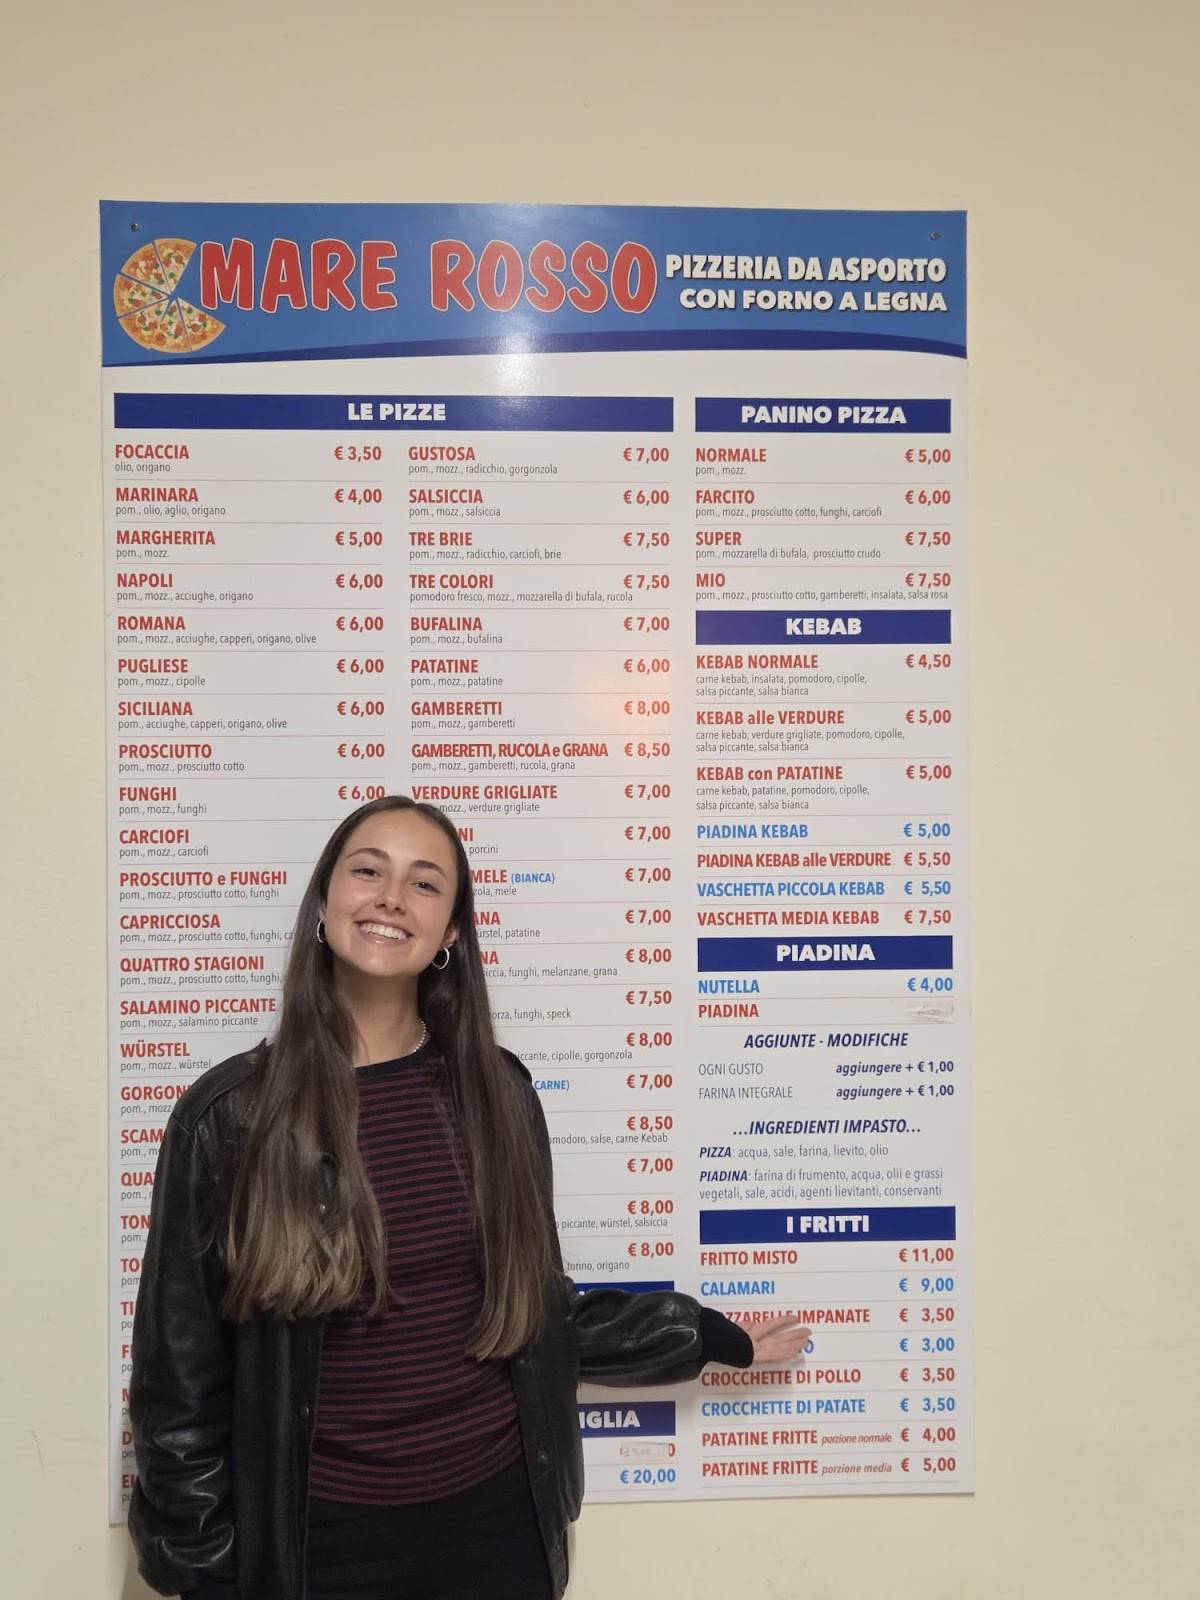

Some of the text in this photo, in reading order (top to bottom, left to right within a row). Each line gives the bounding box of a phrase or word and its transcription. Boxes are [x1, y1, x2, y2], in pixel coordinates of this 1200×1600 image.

[200, 238, 657, 314] MARE ROSSO
[666, 255, 946, 282] PIZZERIA DA ASPORTO
[680, 288, 947, 312] CON FORNO A LEGNA
[348, 404, 446, 421] LE PIZZE
[741, 406, 907, 424] PANINO PIZZA
[115, 444, 190, 460] FOCACCIA
[334, 446, 382, 462] € 3,50
[408, 446, 476, 461] GUSTOSA
[623, 447, 670, 464] € 7,00
[696, 448, 767, 463] NORMALE
[904, 448, 951, 465] € 5,00
[115, 461, 171, 474] olio, origano
[466, 463, 507, 475] radicchio,
[509, 463, 558, 477] gorgonzola
[116, 487, 199, 502] MARINARA
[334, 488, 383, 505] € 4,00
[409, 489, 484, 504] SALSICCIA
[696, 489, 755, 504] FARCITO
[143, 505, 163, 517] olio,
[165, 505, 189, 518] aglio,
[191, 507, 226, 518] origano
[116, 530, 216, 545] MARGHERITA
[335, 531, 383, 548] € 5,00
[408, 531, 472, 546] TRE BRIE
[696, 531, 742, 546] SUPER
[117, 573, 173, 588] NAPOLI
[409, 574, 493, 589] TRE COLORI
[623, 574, 670, 591] € 7,50
[696, 573, 726, 588] MIO
[175, 590, 217, 604] acciughe,
[219, 591, 254, 604] origano
[117, 616, 186, 631] ROMANA
[411, 616, 483, 631] BUFALINA
[786, 618, 862, 635] KEBAB
[118, 658, 188, 673] PUGLIESE
[411, 659, 479, 673] PATATINE
[696, 654, 819, 669] KEBAB NORMALE
[905, 654, 951, 670] € 4,50
[176, 675, 207, 689] cipolle
[467, 676, 503, 688] patatine
[696, 673, 867, 686] carne kebab, insalata, pomodoro, cipolle,
[118, 701, 193, 716] SICILIANA
[337, 701, 385, 718] € 6,00
[411, 701, 502, 716] GAMBERETTI
[696, 710, 845, 725] KEBAB alle VERDURE
[119, 744, 212, 759] PROSCIUTTO
[411, 743, 609, 760] GAMBERETTI, RUCOLA e GRANA
[119, 786, 176, 802] FUNGHI
[411, 785, 557, 800] VERDURE GRIGLIATE
[119, 829, 189, 844] CARCIOFI
[697, 824, 808, 839] PIADINA KEBAB
[903, 822, 951, 839] € 5,00
[177, 845, 209, 856] carciofi
[120, 871, 287, 887] PROSCIUTTO e FUNGHI
[120, 914, 221, 930] CAPRICCIOSA
[625, 948, 672, 965] € 8,00
[777, 944, 875, 962] PIADINA
[120, 956, 264, 973] QUATTRO STAGIONI
[698, 979, 760, 994] NUTELLA
[120, 998, 277, 1015] SALAMINO PICCANTE
[698, 1003, 759, 1018] PIADINA
[179, 1016, 219, 1027] salamino
[222, 1016, 259, 1029] piccante
[743, 1034, 816, 1048] AGGIUNTE
[827, 1032, 909, 1047] MODIFICHE
[120, 1039, 190, 1058] WÜRSTEL
[698, 1062, 763, 1076] OGNI GUSTO
[836, 1060, 954, 1077] aggiungere + € 1,00
[738, 1148, 771, 1161] acqua,
[773, 1145, 796, 1158] sale,
[799, 1144, 831, 1158] farina,
[833, 1144, 867, 1158] lievito,
[869, 1144, 889, 1156] olio
[787, 1215, 869, 1233] I FRITTI
[700, 1250, 798, 1266] FRITTO MISTO
[898, 1247, 954, 1264] € 11,00
[700, 1280, 775, 1296] CALAMARI
[898, 1277, 954, 1294] € 9,00
[701, 1369, 861, 1387] CROCCHETTE DI POLLO
[701, 1399, 865, 1417] CROCCHETTE DI PATATE
[702, 1460, 892, 1477] PATATINE FRITTE porzione media
[900, 1457, 956, 1474] € 5,00
[620, 1468, 676, 1485] € 20,00
